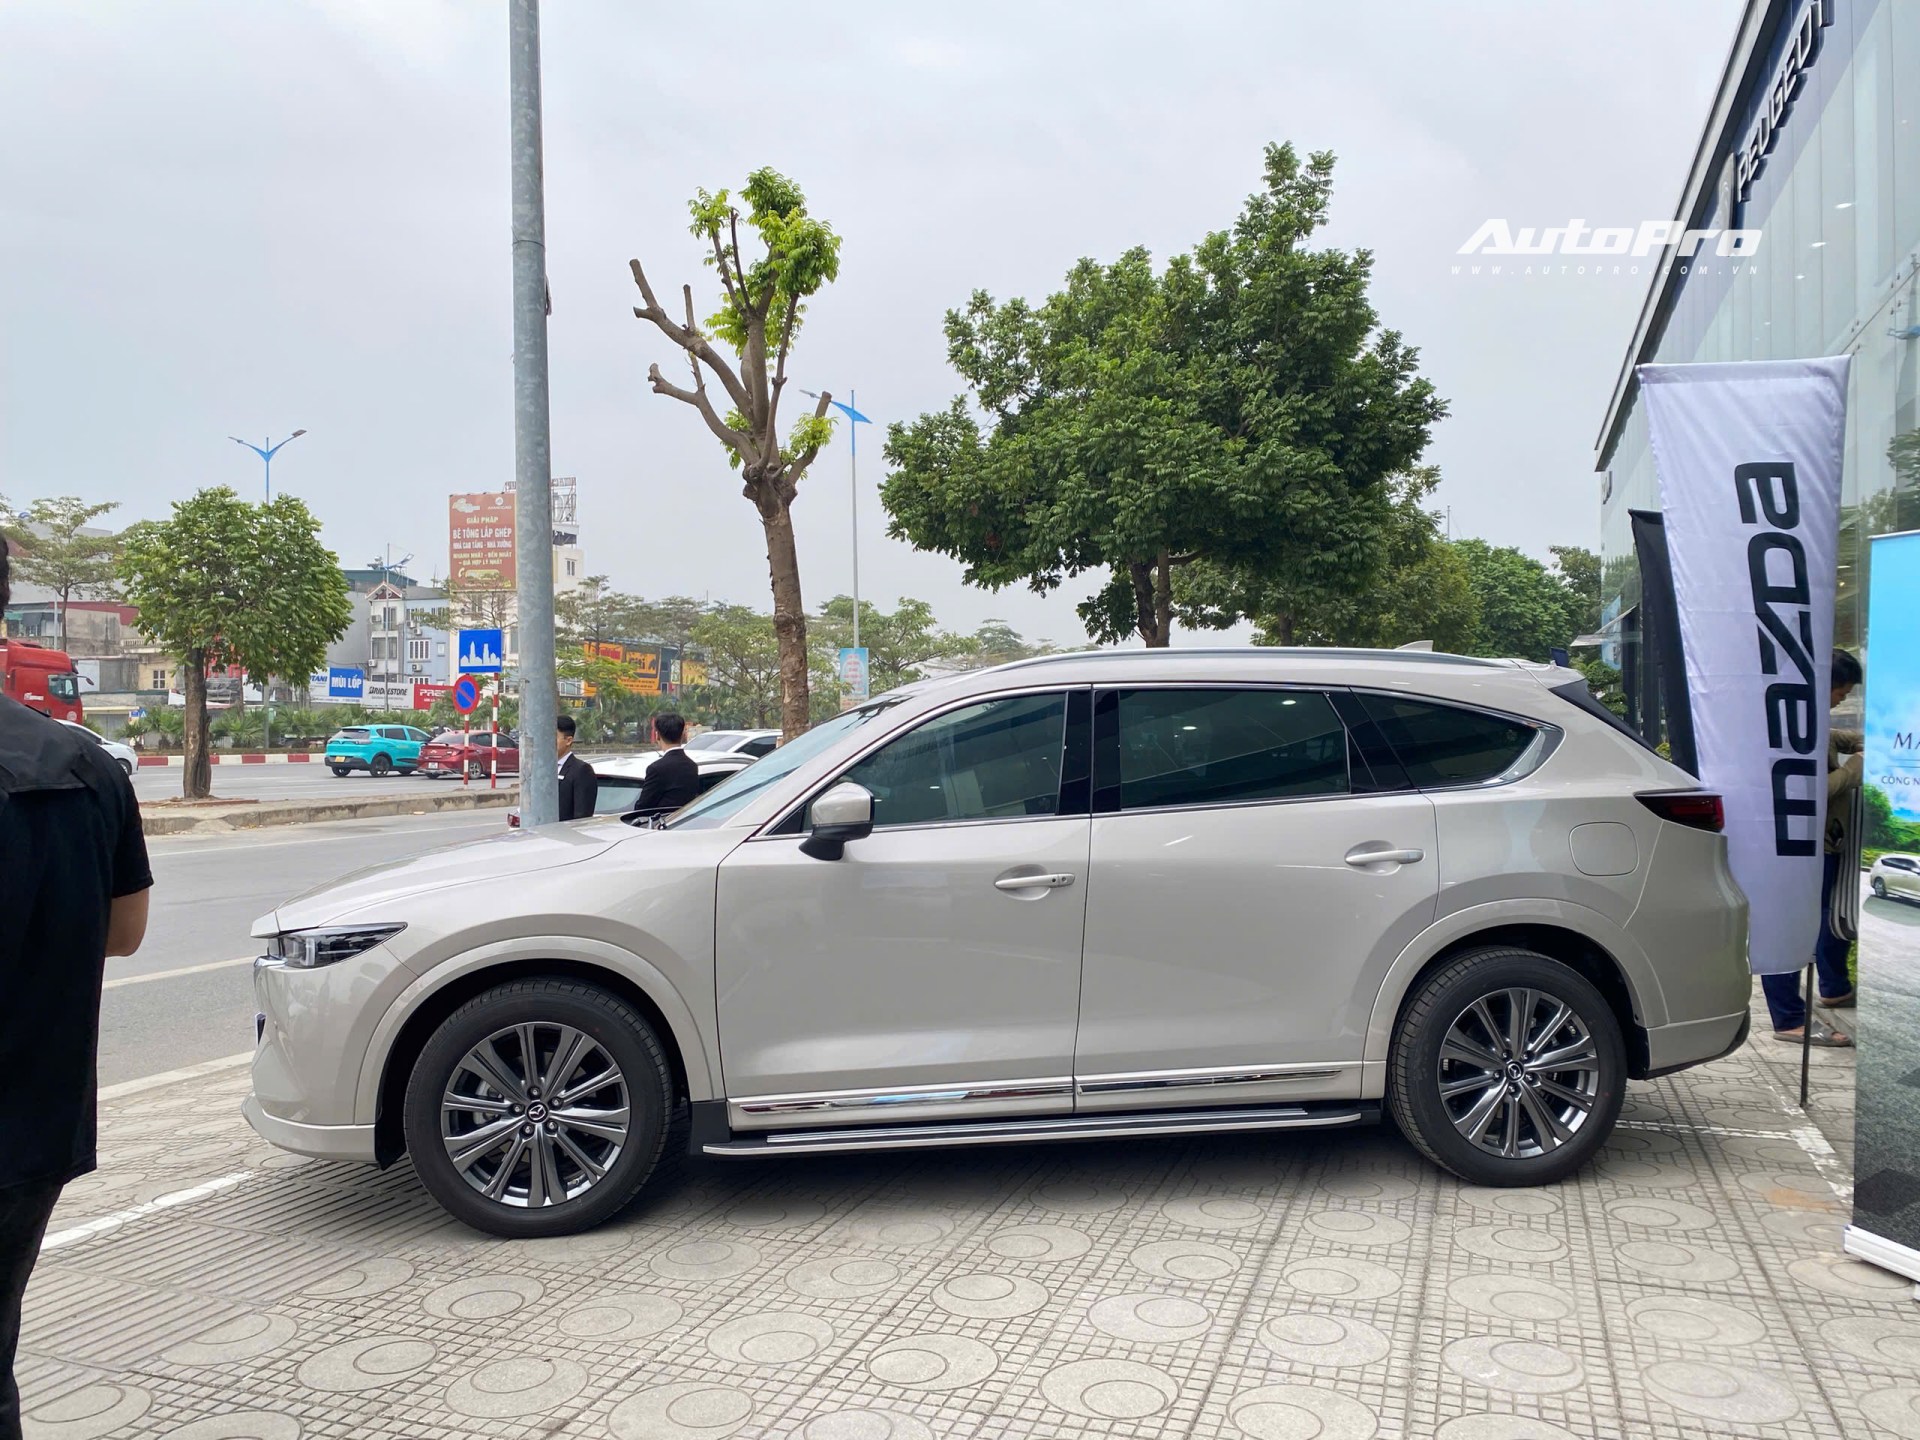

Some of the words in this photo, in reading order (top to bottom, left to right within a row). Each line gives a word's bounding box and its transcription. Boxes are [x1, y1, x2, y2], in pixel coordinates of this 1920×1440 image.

[453, 529, 461, 539] BÊ
[463, 528, 479, 538] TÔNG
[480, 525, 493, 538] LẮP
[495, 526, 512, 538] GHÉP
[1734, 461, 1817, 857] mazda
[347, 674, 362, 689] LỐP
[1881, 773, 1911, 786] CÔNG
